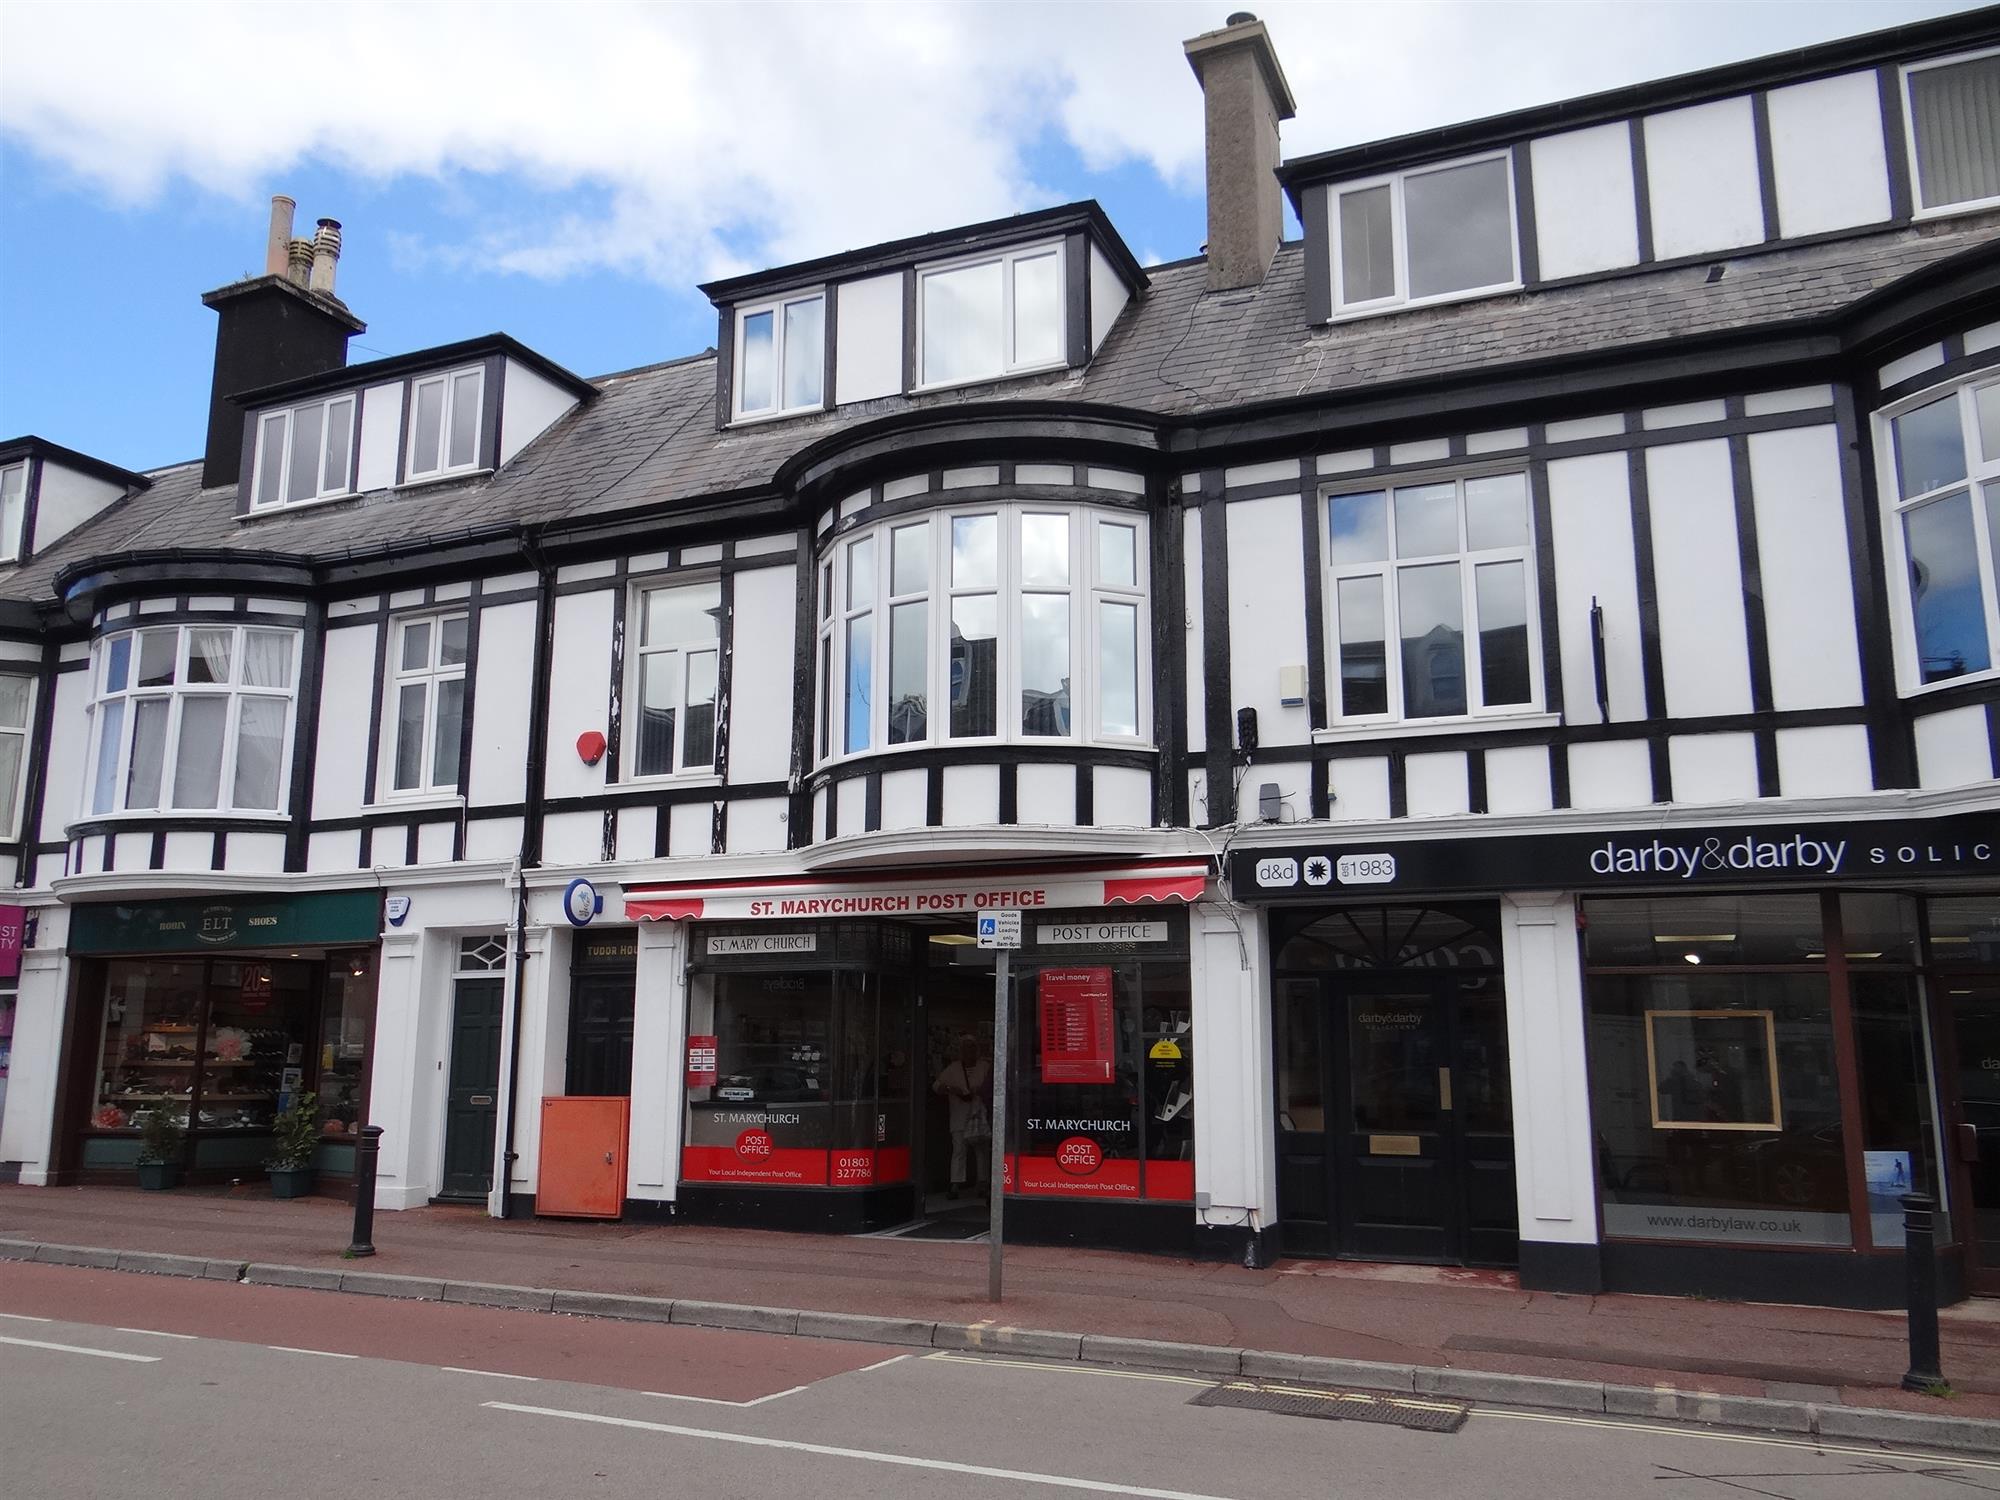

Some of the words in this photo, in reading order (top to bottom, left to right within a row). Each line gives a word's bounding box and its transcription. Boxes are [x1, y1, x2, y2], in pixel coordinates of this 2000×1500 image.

[1590, 834, 1846, 878] darby&darby
[1870, 844, 1992, 864] SOLIC
[1260, 863, 1294, 880] d&d
[1341, 863, 1349, 877] est
[1351, 860, 1393, 876] 1983
[750, 901, 774, 916] ST.
[781, 895, 910, 915] MARYCHURCH
[916, 893, 967, 910] POST
[973, 890, 1046, 908] OFFICE
[203, 917, 232, 931] ELT
[248, 916, 278, 926] SHOES
[1052, 926, 1092, 941] POST
[1098, 925, 1151, 939] OFFICE
[711, 939, 726, 952] ST.
[728, 938, 760, 951] MARY
[764, 936, 811, 950] CHURCH
[586, 945, 617, 956] TUDOR
[1045, 973, 1066, 981] Travel
[1067, 974, 1091, 982] money
[1358, 1012, 1422, 1025] darby&darby
[713, 1112, 727, 1124] ST.
[729, 1113, 800, 1124] MARYCHURCH
[1027, 1119, 1042, 1130] ST.
[1045, 1119, 1131, 1131] MARYCHURCH
[745, 1136, 767, 1145] POST
[740, 1145, 770, 1154] OFFICE
[1066, 1144, 1092, 1154] POST
[839, 1157, 870, 1167] 01803
[1060, 1155, 1096, 1165] OFFICE
[708, 1168, 721, 1176] Your
[721, 1168, 736, 1176] Local
[736, 1169, 771, 1178] Independent
[836, 1168, 872, 1179] 327786
[1023, 1180, 1039, 1188] Your
[1040, 1180, 1056, 1188] Local
[1057, 1182, 1099, 1191] Independent
[1647, 1215, 1802, 1232] www.darbylaw.co.uk
